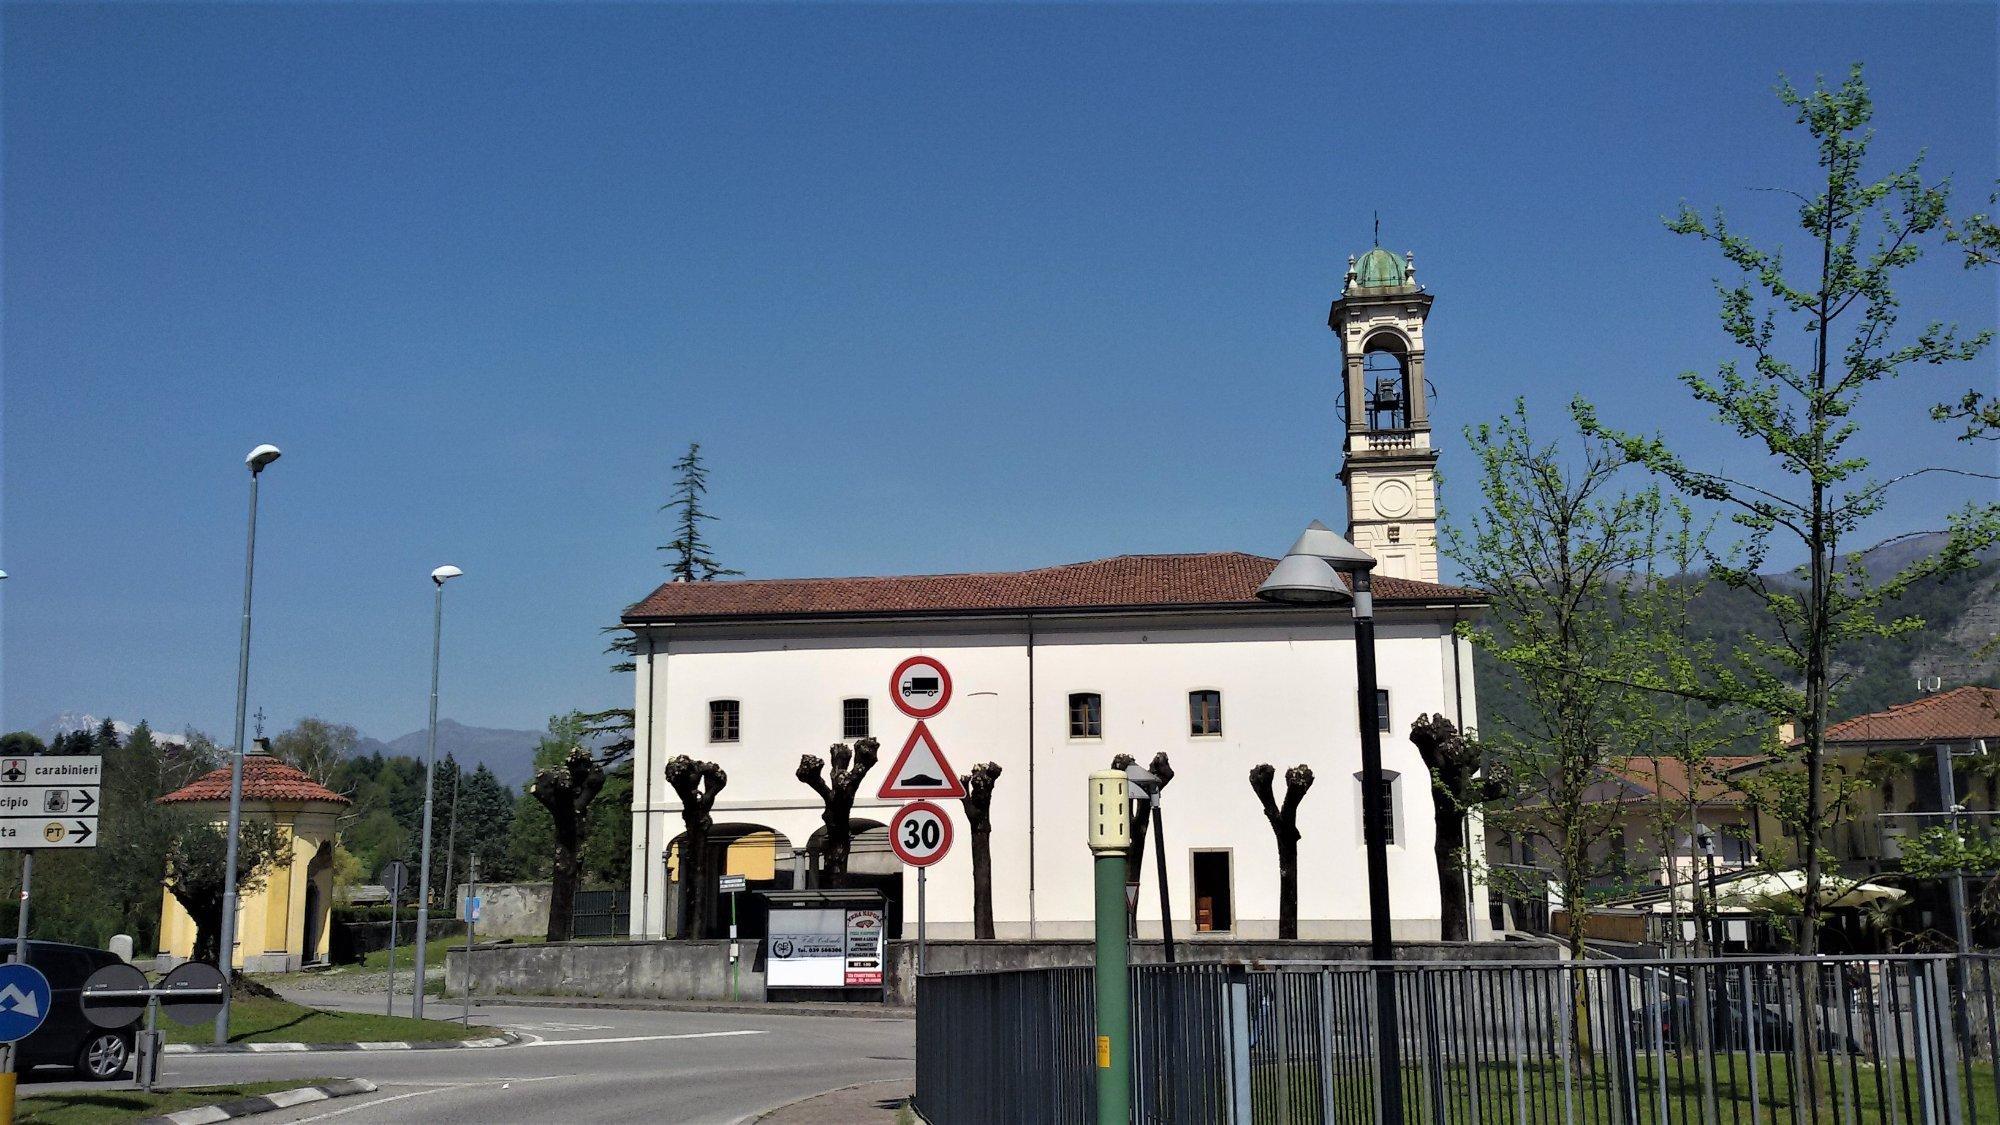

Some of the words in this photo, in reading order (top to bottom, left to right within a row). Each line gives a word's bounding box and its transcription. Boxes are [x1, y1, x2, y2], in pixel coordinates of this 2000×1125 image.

[35, 765, 98, 775] carabinieri
[46, 828, 62, 837] PT
[904, 819, 940, 849] 30
